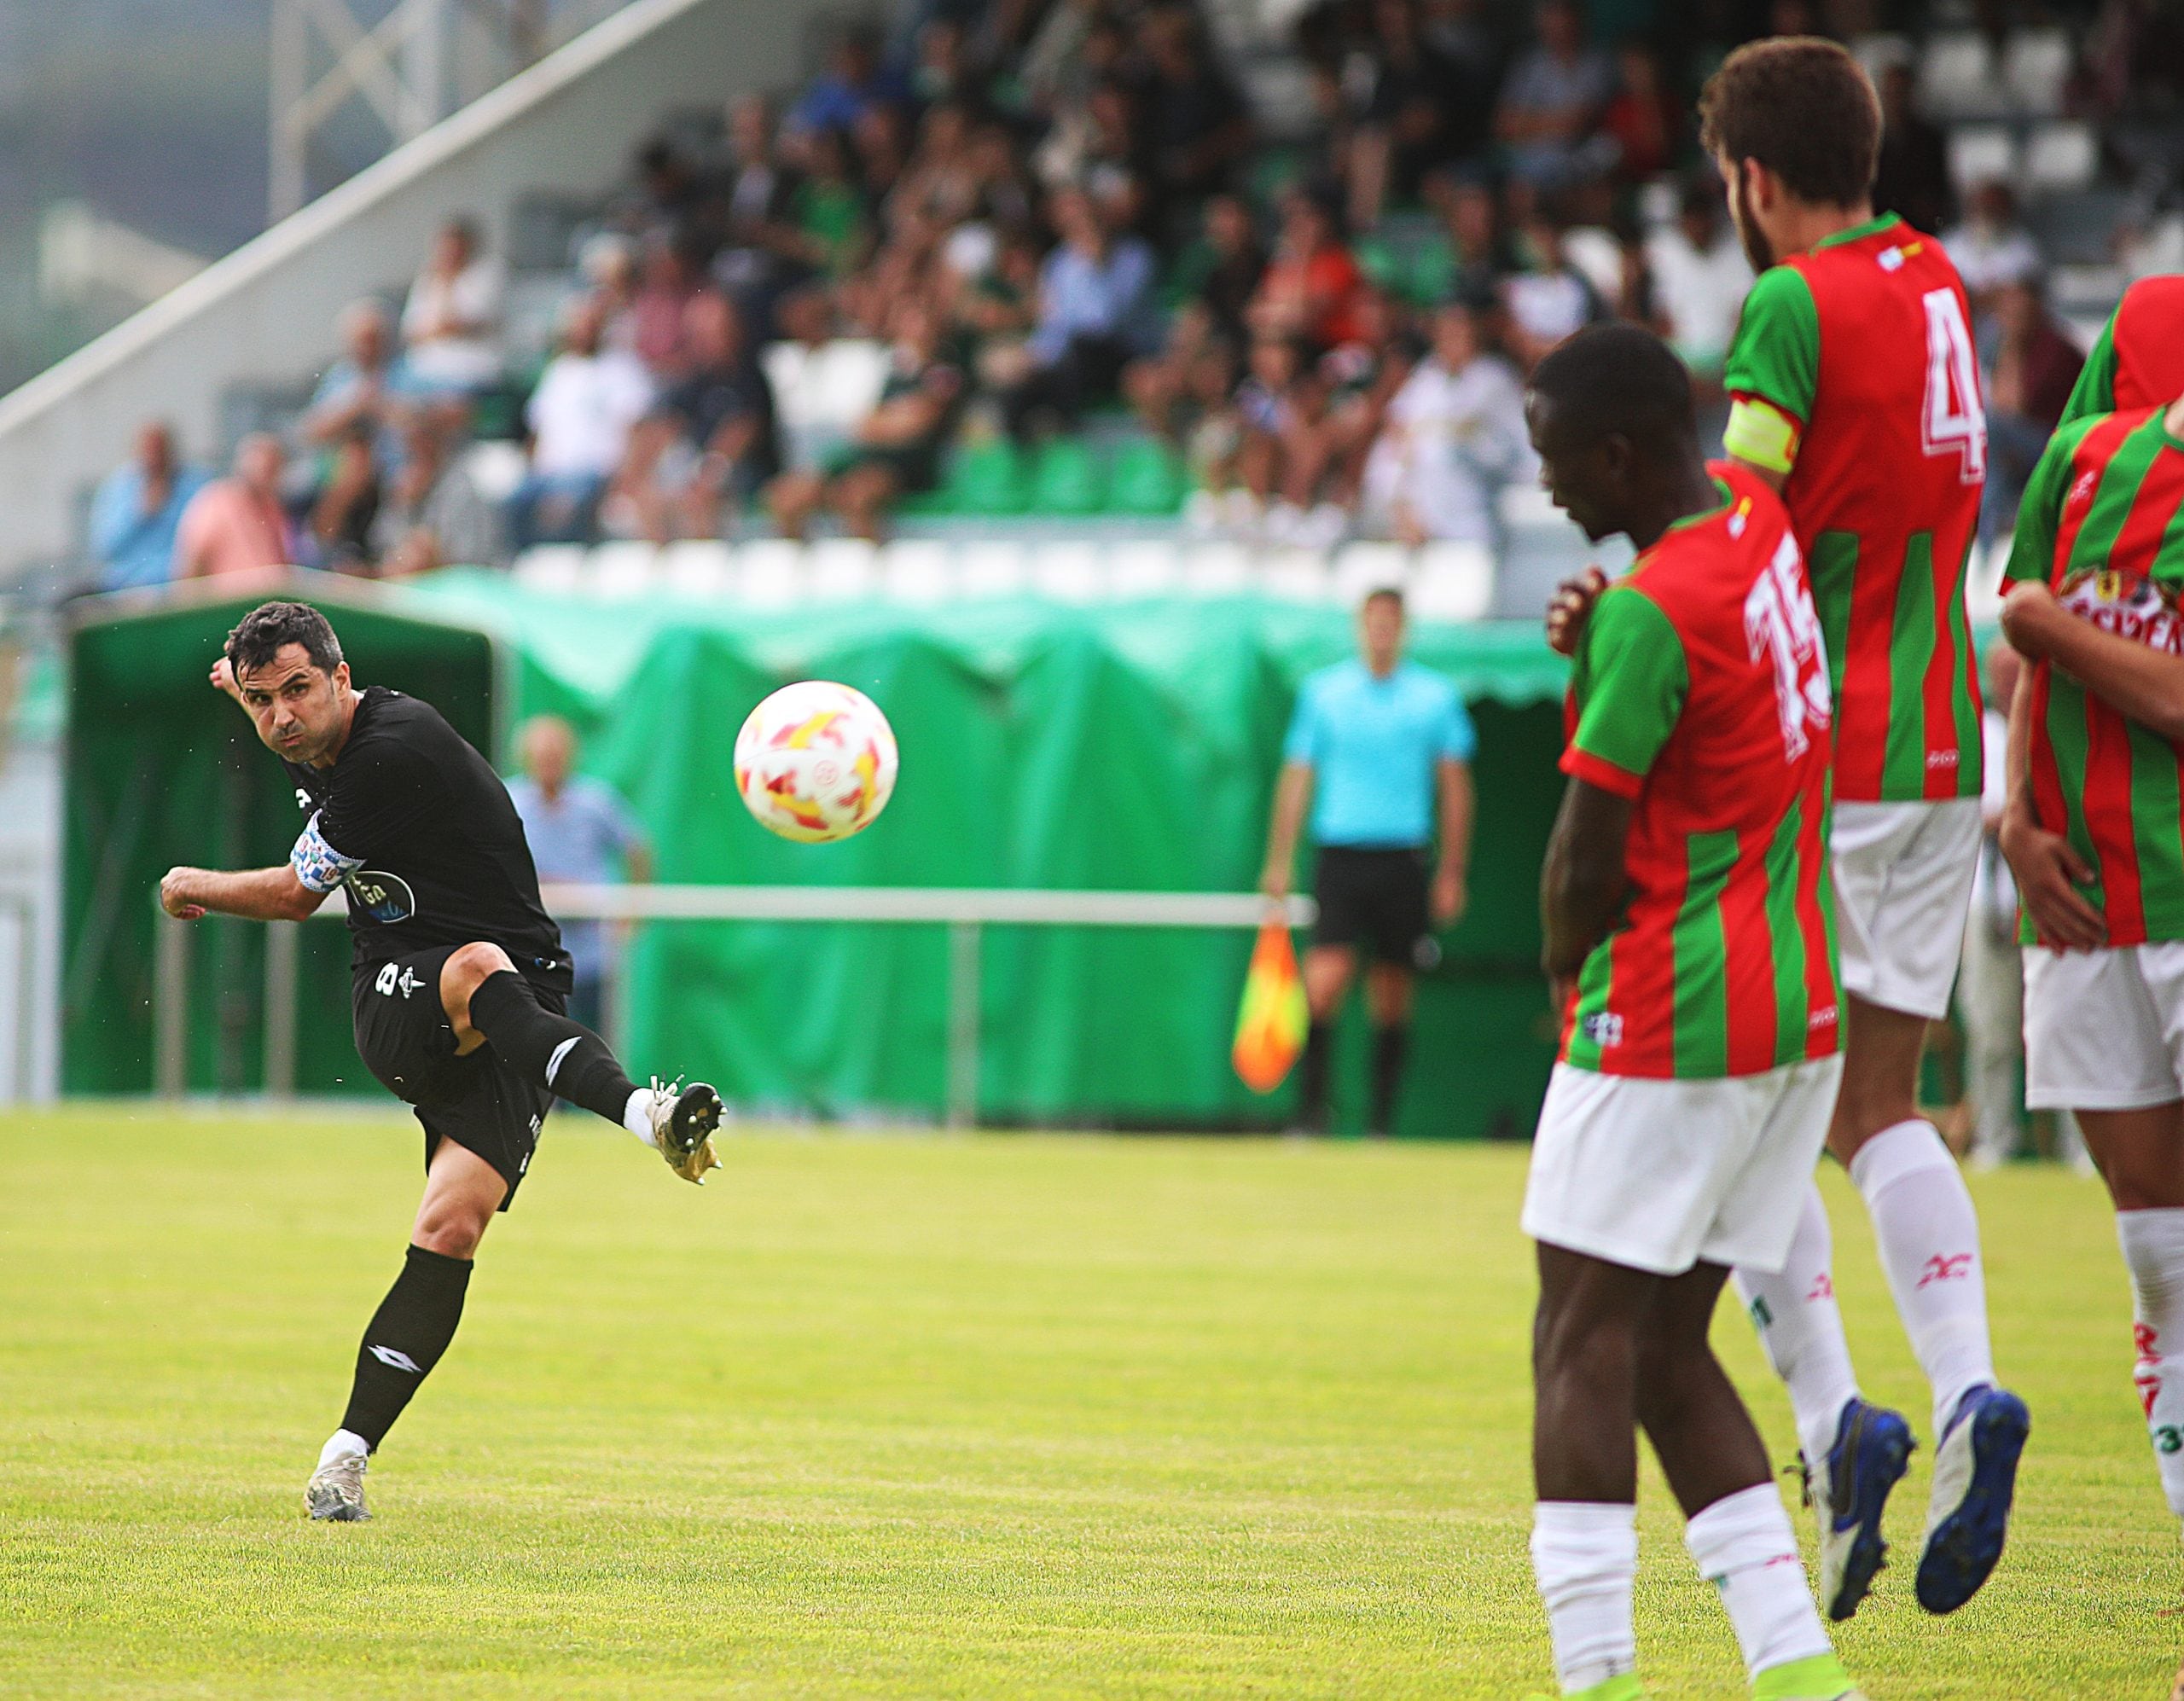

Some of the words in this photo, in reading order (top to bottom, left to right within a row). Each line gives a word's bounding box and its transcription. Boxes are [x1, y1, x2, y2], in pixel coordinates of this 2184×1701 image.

[1922, 287, 1988, 486] 4
[1743, 528, 1834, 764] 15
[320, 866, 339, 882] 19
